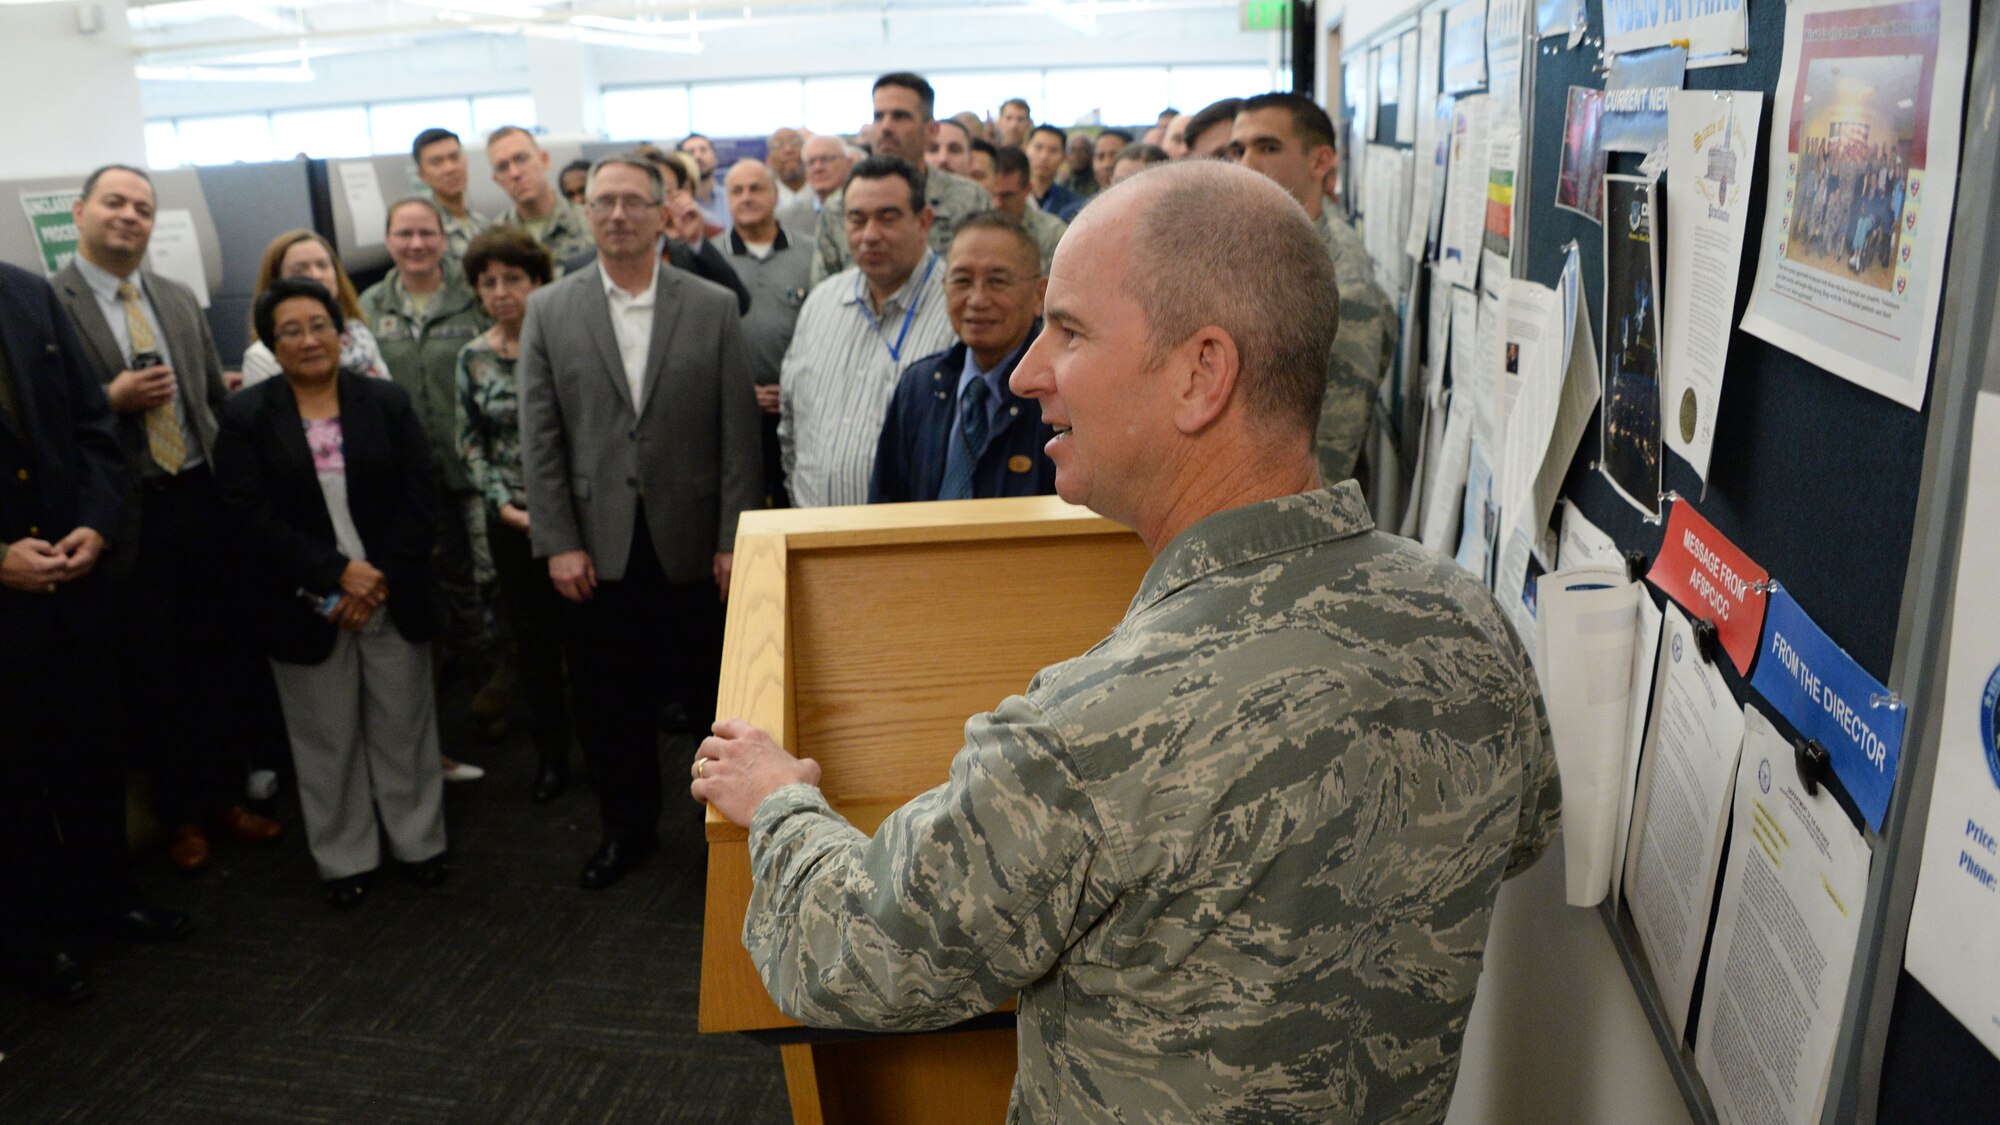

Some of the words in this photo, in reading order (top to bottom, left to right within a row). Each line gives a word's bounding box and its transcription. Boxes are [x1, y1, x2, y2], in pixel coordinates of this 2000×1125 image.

[1604, 88, 1649, 112] CURRENT
[1650, 86, 1679, 112] NEW
[1683, 528, 1720, 578] MESSAGE
[1720, 563, 1746, 603] FROM
[1689, 567, 1730, 621] AFSPC/CC
[1772, 631, 1799, 680] FROM
[1800, 662, 1821, 704] THE
[1823, 686, 1886, 773] DIRECTOR
[1966, 817, 1998, 855] Price:
[1958, 850, 1998, 892] Phone:
